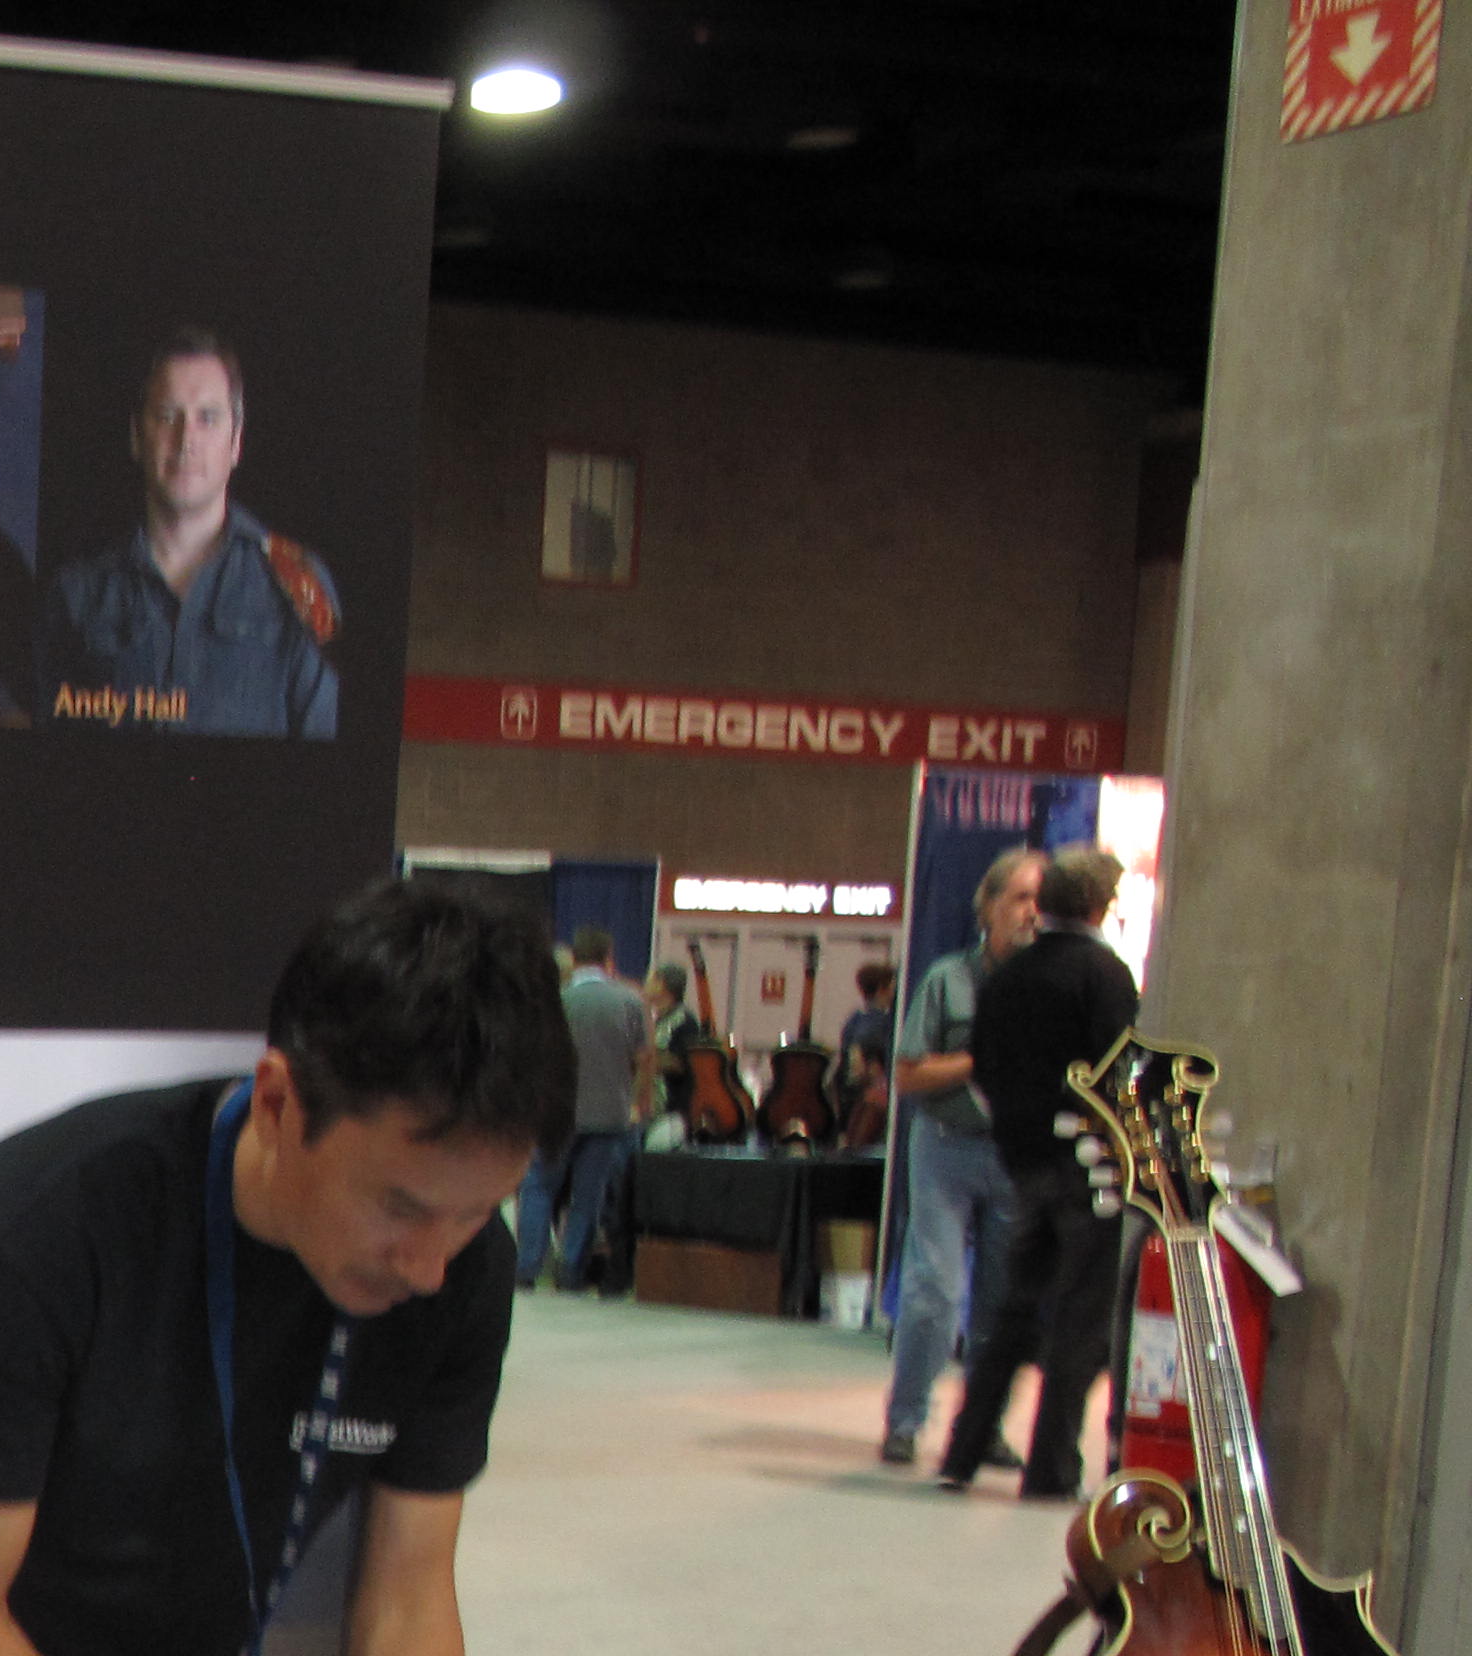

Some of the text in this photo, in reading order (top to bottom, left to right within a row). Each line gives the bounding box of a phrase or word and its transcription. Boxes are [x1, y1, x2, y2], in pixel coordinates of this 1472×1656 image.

[54, 682, 188, 723] Andy Hall
[558, 690, 1047, 763] EMERGENCY EXIT
[673, 877, 828, 915] EMERGENCY
